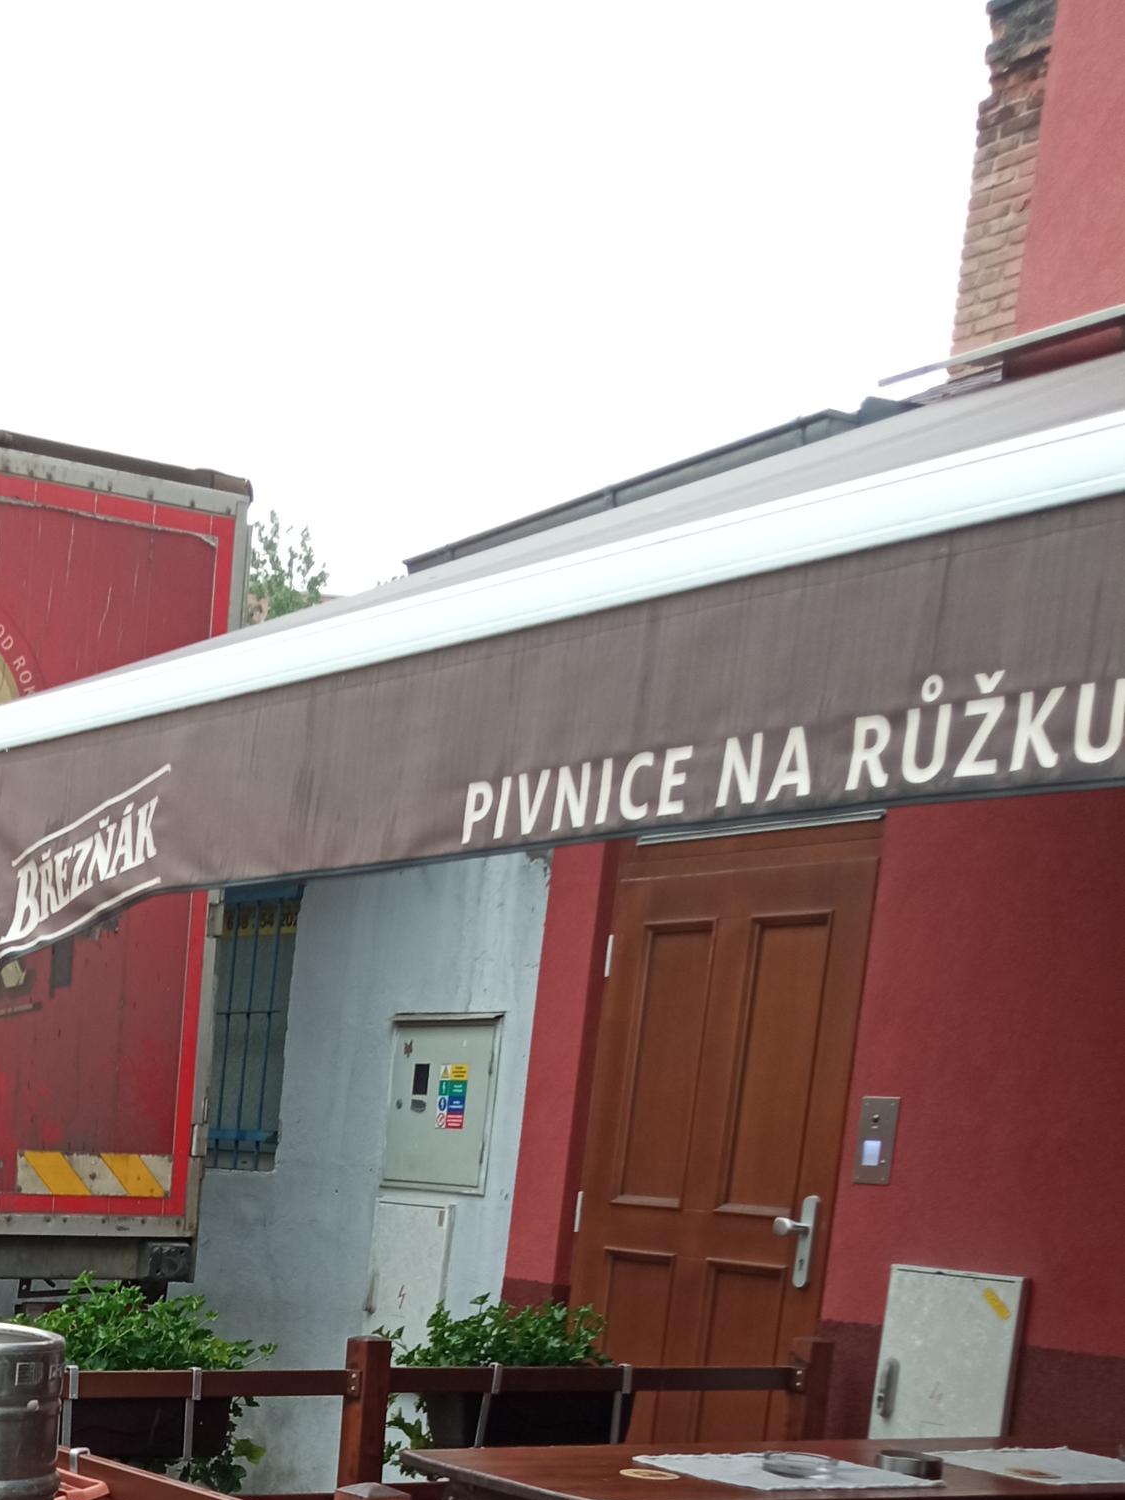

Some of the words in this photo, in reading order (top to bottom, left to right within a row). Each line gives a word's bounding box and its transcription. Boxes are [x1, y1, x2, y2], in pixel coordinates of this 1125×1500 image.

[460, 744, 694, 846] PIVNICE
[714, 726, 812, 810] NA
[843, 669, 1125, 791] RŮŽKU
